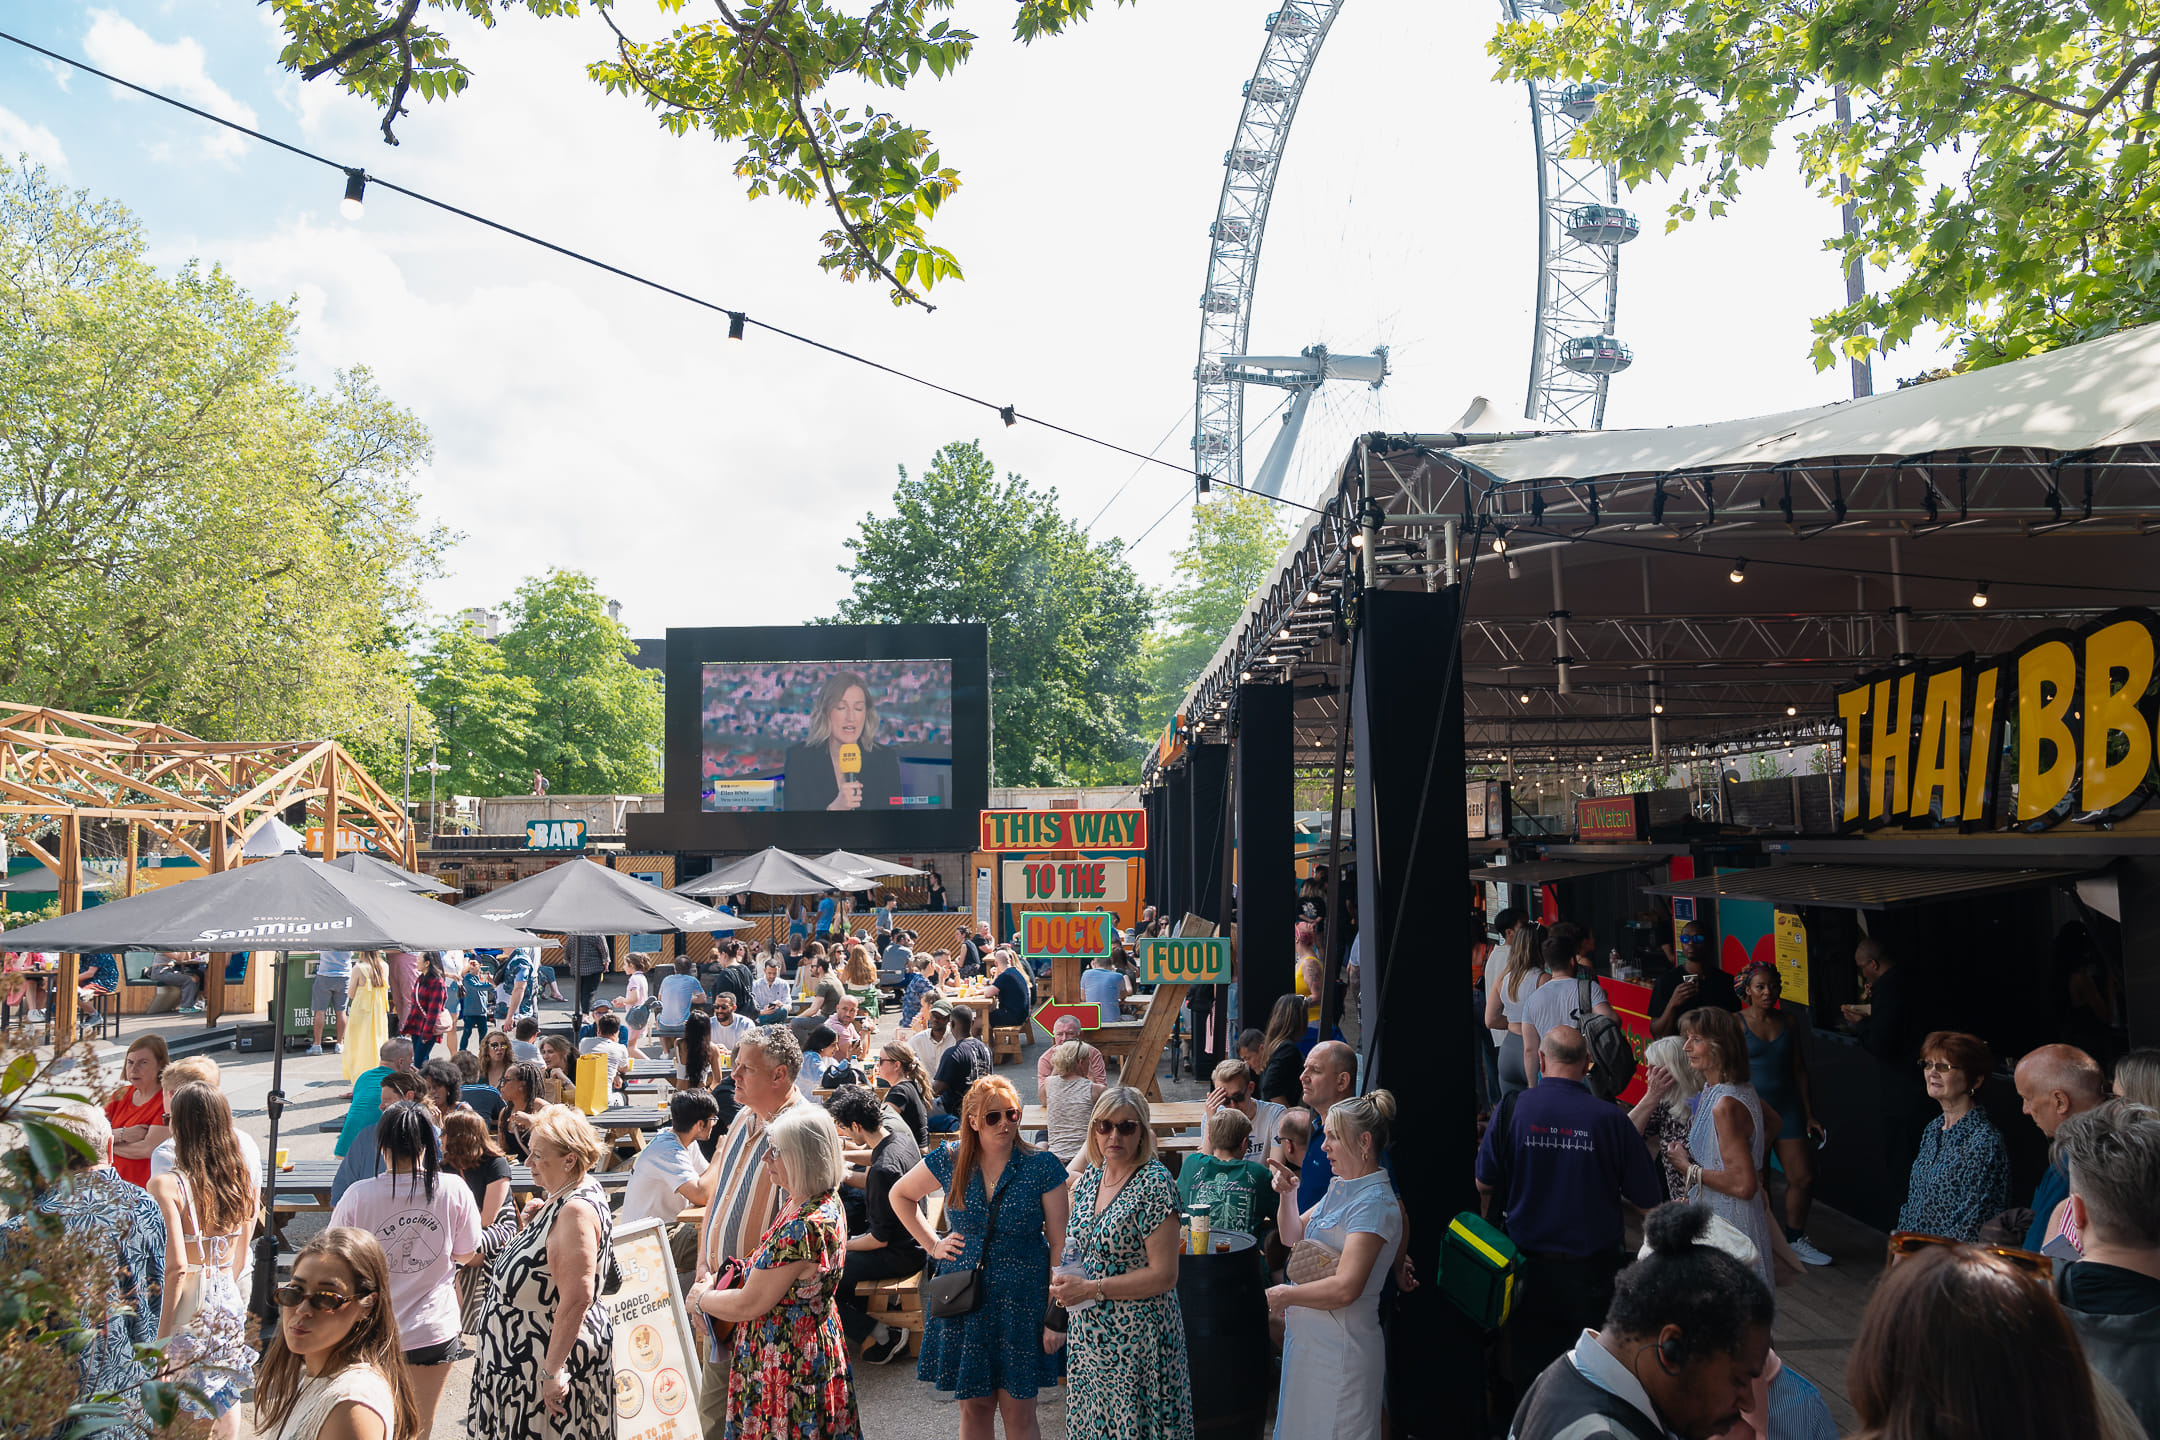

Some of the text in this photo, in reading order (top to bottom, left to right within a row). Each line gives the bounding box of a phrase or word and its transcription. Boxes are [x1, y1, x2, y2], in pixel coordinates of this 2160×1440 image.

[1838, 621, 2160, 823] THAI BB
[1467, 803, 1484, 817] GERS
[313, 830, 379, 850] TILETS
[534, 822, 579, 848] BAR
[985, 812, 1140, 848] THIS WAY
[1023, 863, 1056, 899] TO
[1058, 863, 1106, 899] THE
[1027, 915, 1105, 954] DOCK
[1147, 941, 1223, 981] FOOD
[293, 1007, 310, 1017] THE
[1550, 1126, 1558, 1134] to
[1573, 1129, 1589, 1137] you
[383, 1224, 396, 1236] La
[614, 1293, 650, 1313] LOADED
[622, 1308, 639, 1323] ICE
[641, 1297, 671, 1316] CREAM
[659, 1417, 677, 1433] THE
